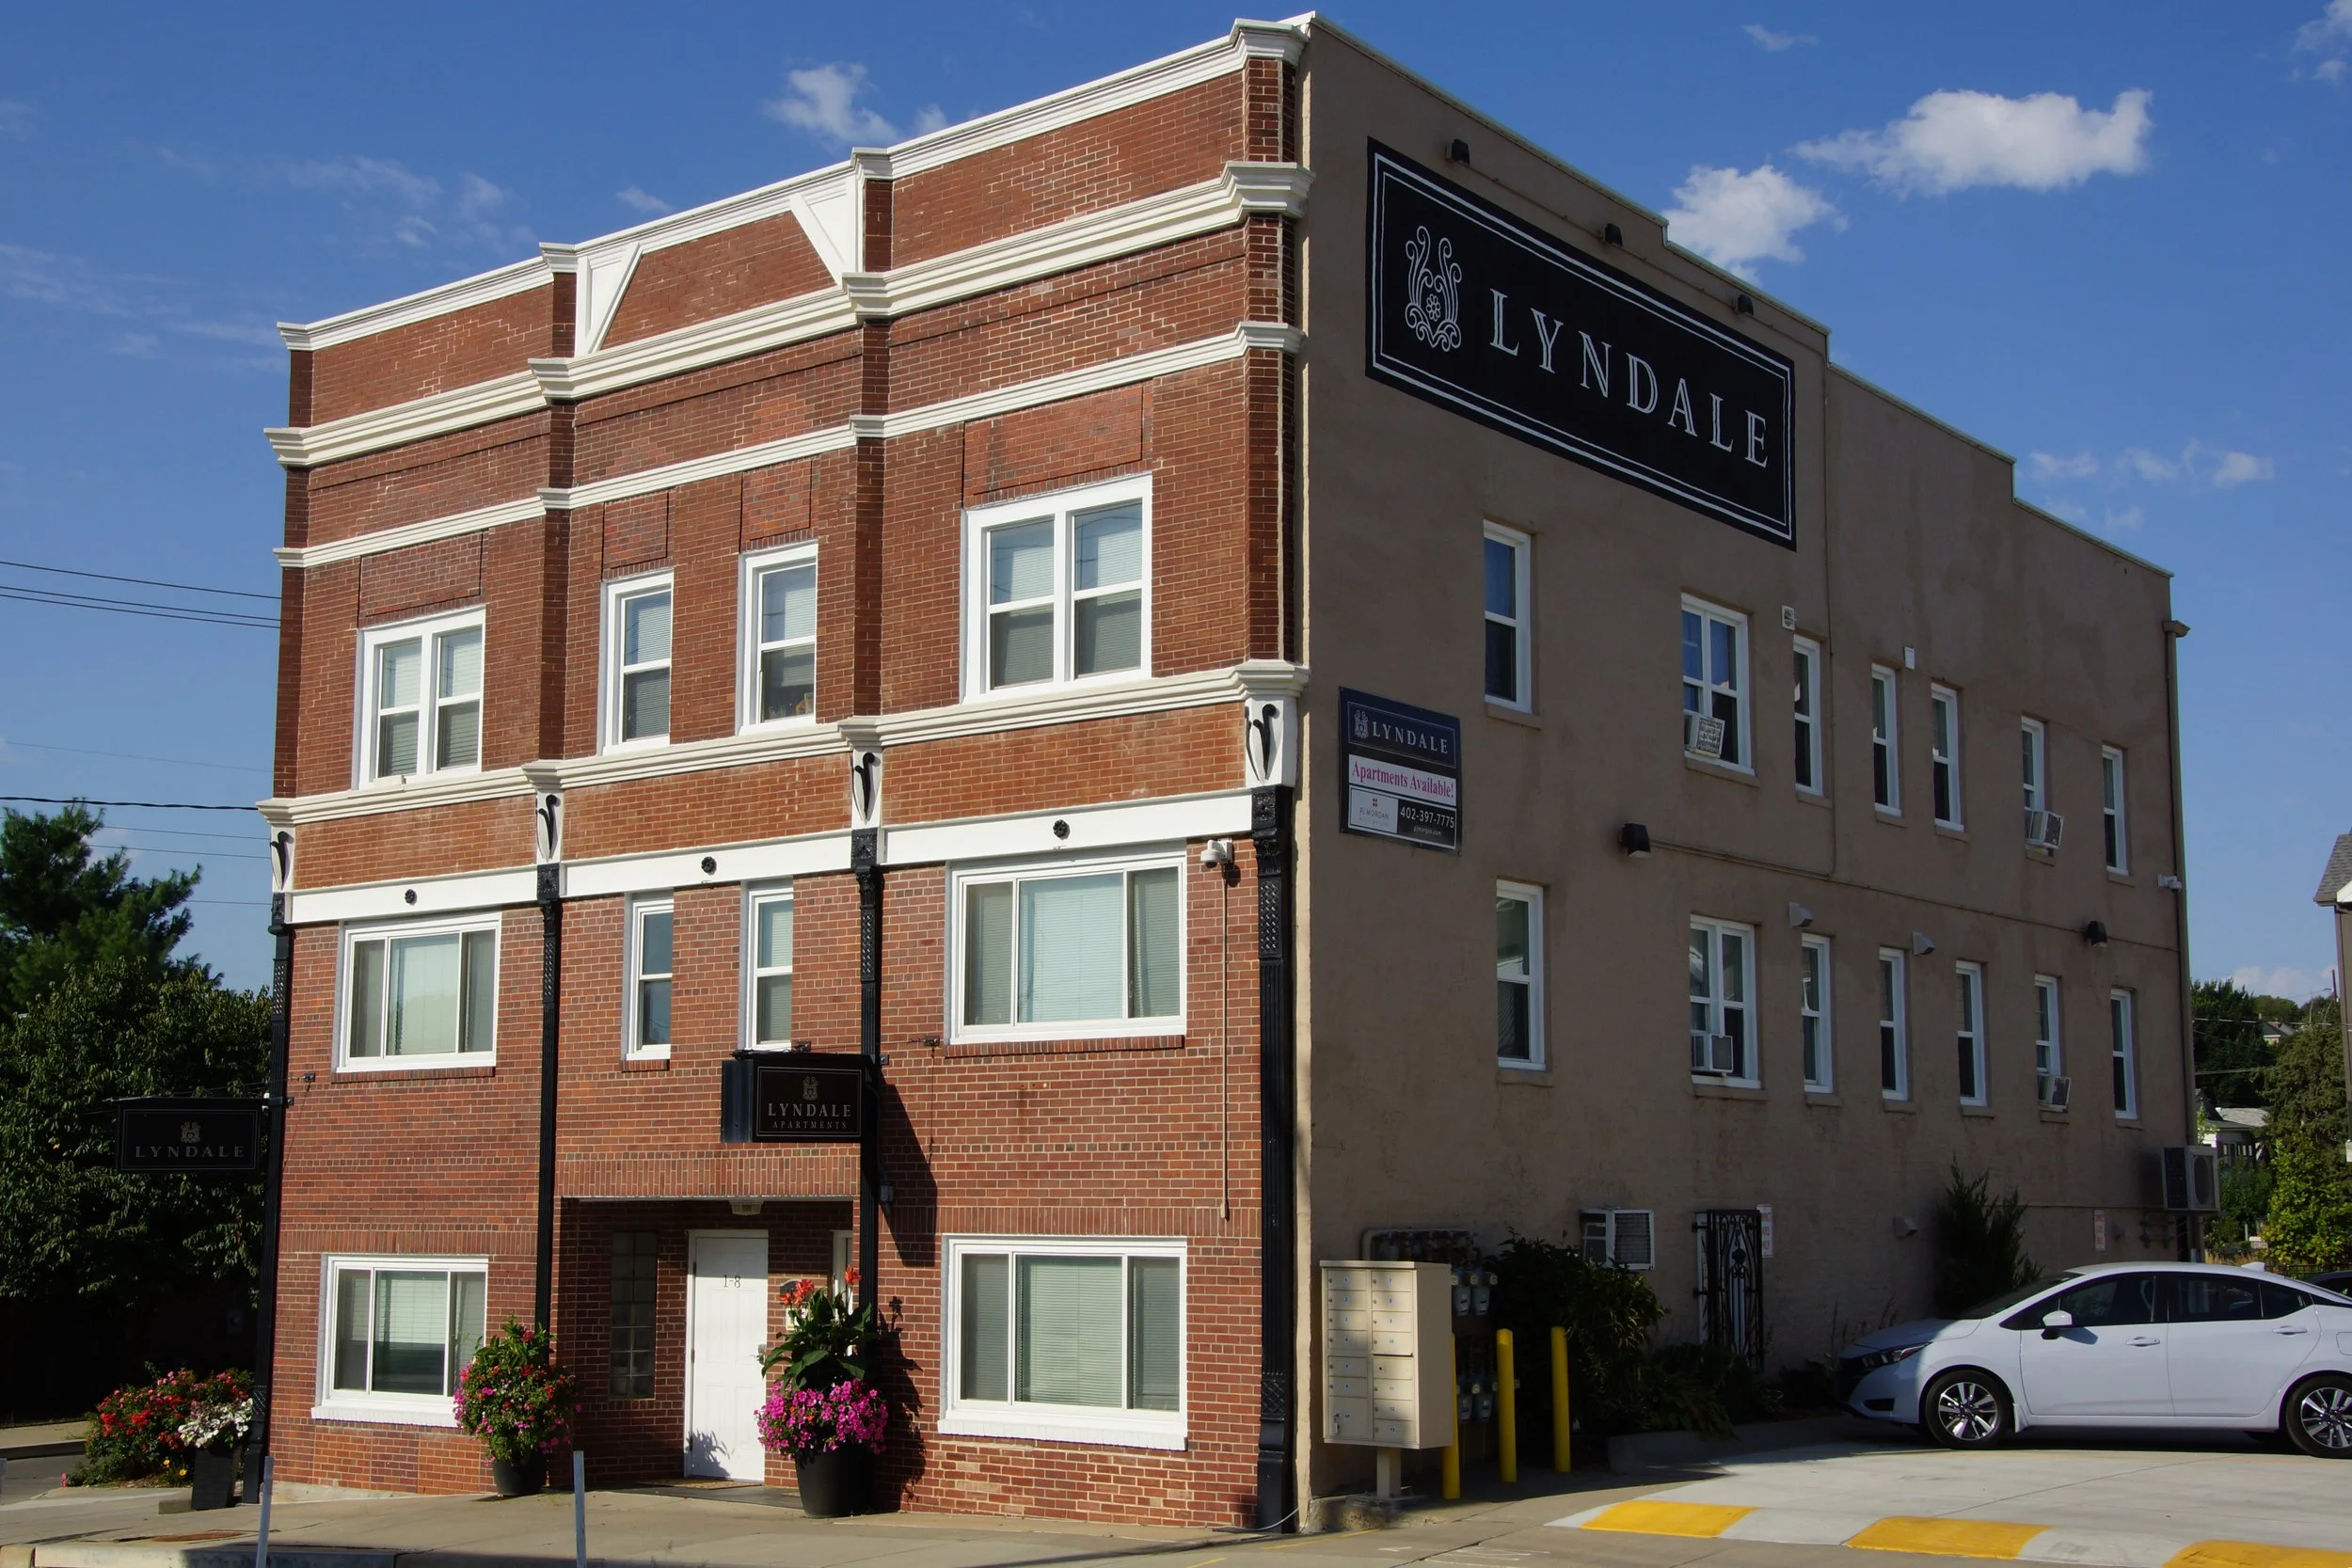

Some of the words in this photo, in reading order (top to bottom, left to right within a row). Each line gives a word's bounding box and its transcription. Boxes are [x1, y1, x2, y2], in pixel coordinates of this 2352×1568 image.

[1489, 288, 1769, 468] LYNDALE
[1372, 721, 1448, 754] LYNDALE
[1352, 761, 1408, 788] Apartments
[1409, 774, 1454, 799] Available!
[1366, 809, 1390, 820] MORGAN
[1400, 806, 1454, 829] 402-397-7775
[768, 1102, 851, 1117] LYNDALE
[772, 1120, 848, 1130] APARTMENTS
[135, 1146, 245, 1158] LYNDALE
[723, 1274, 741, 1289] 1-8
